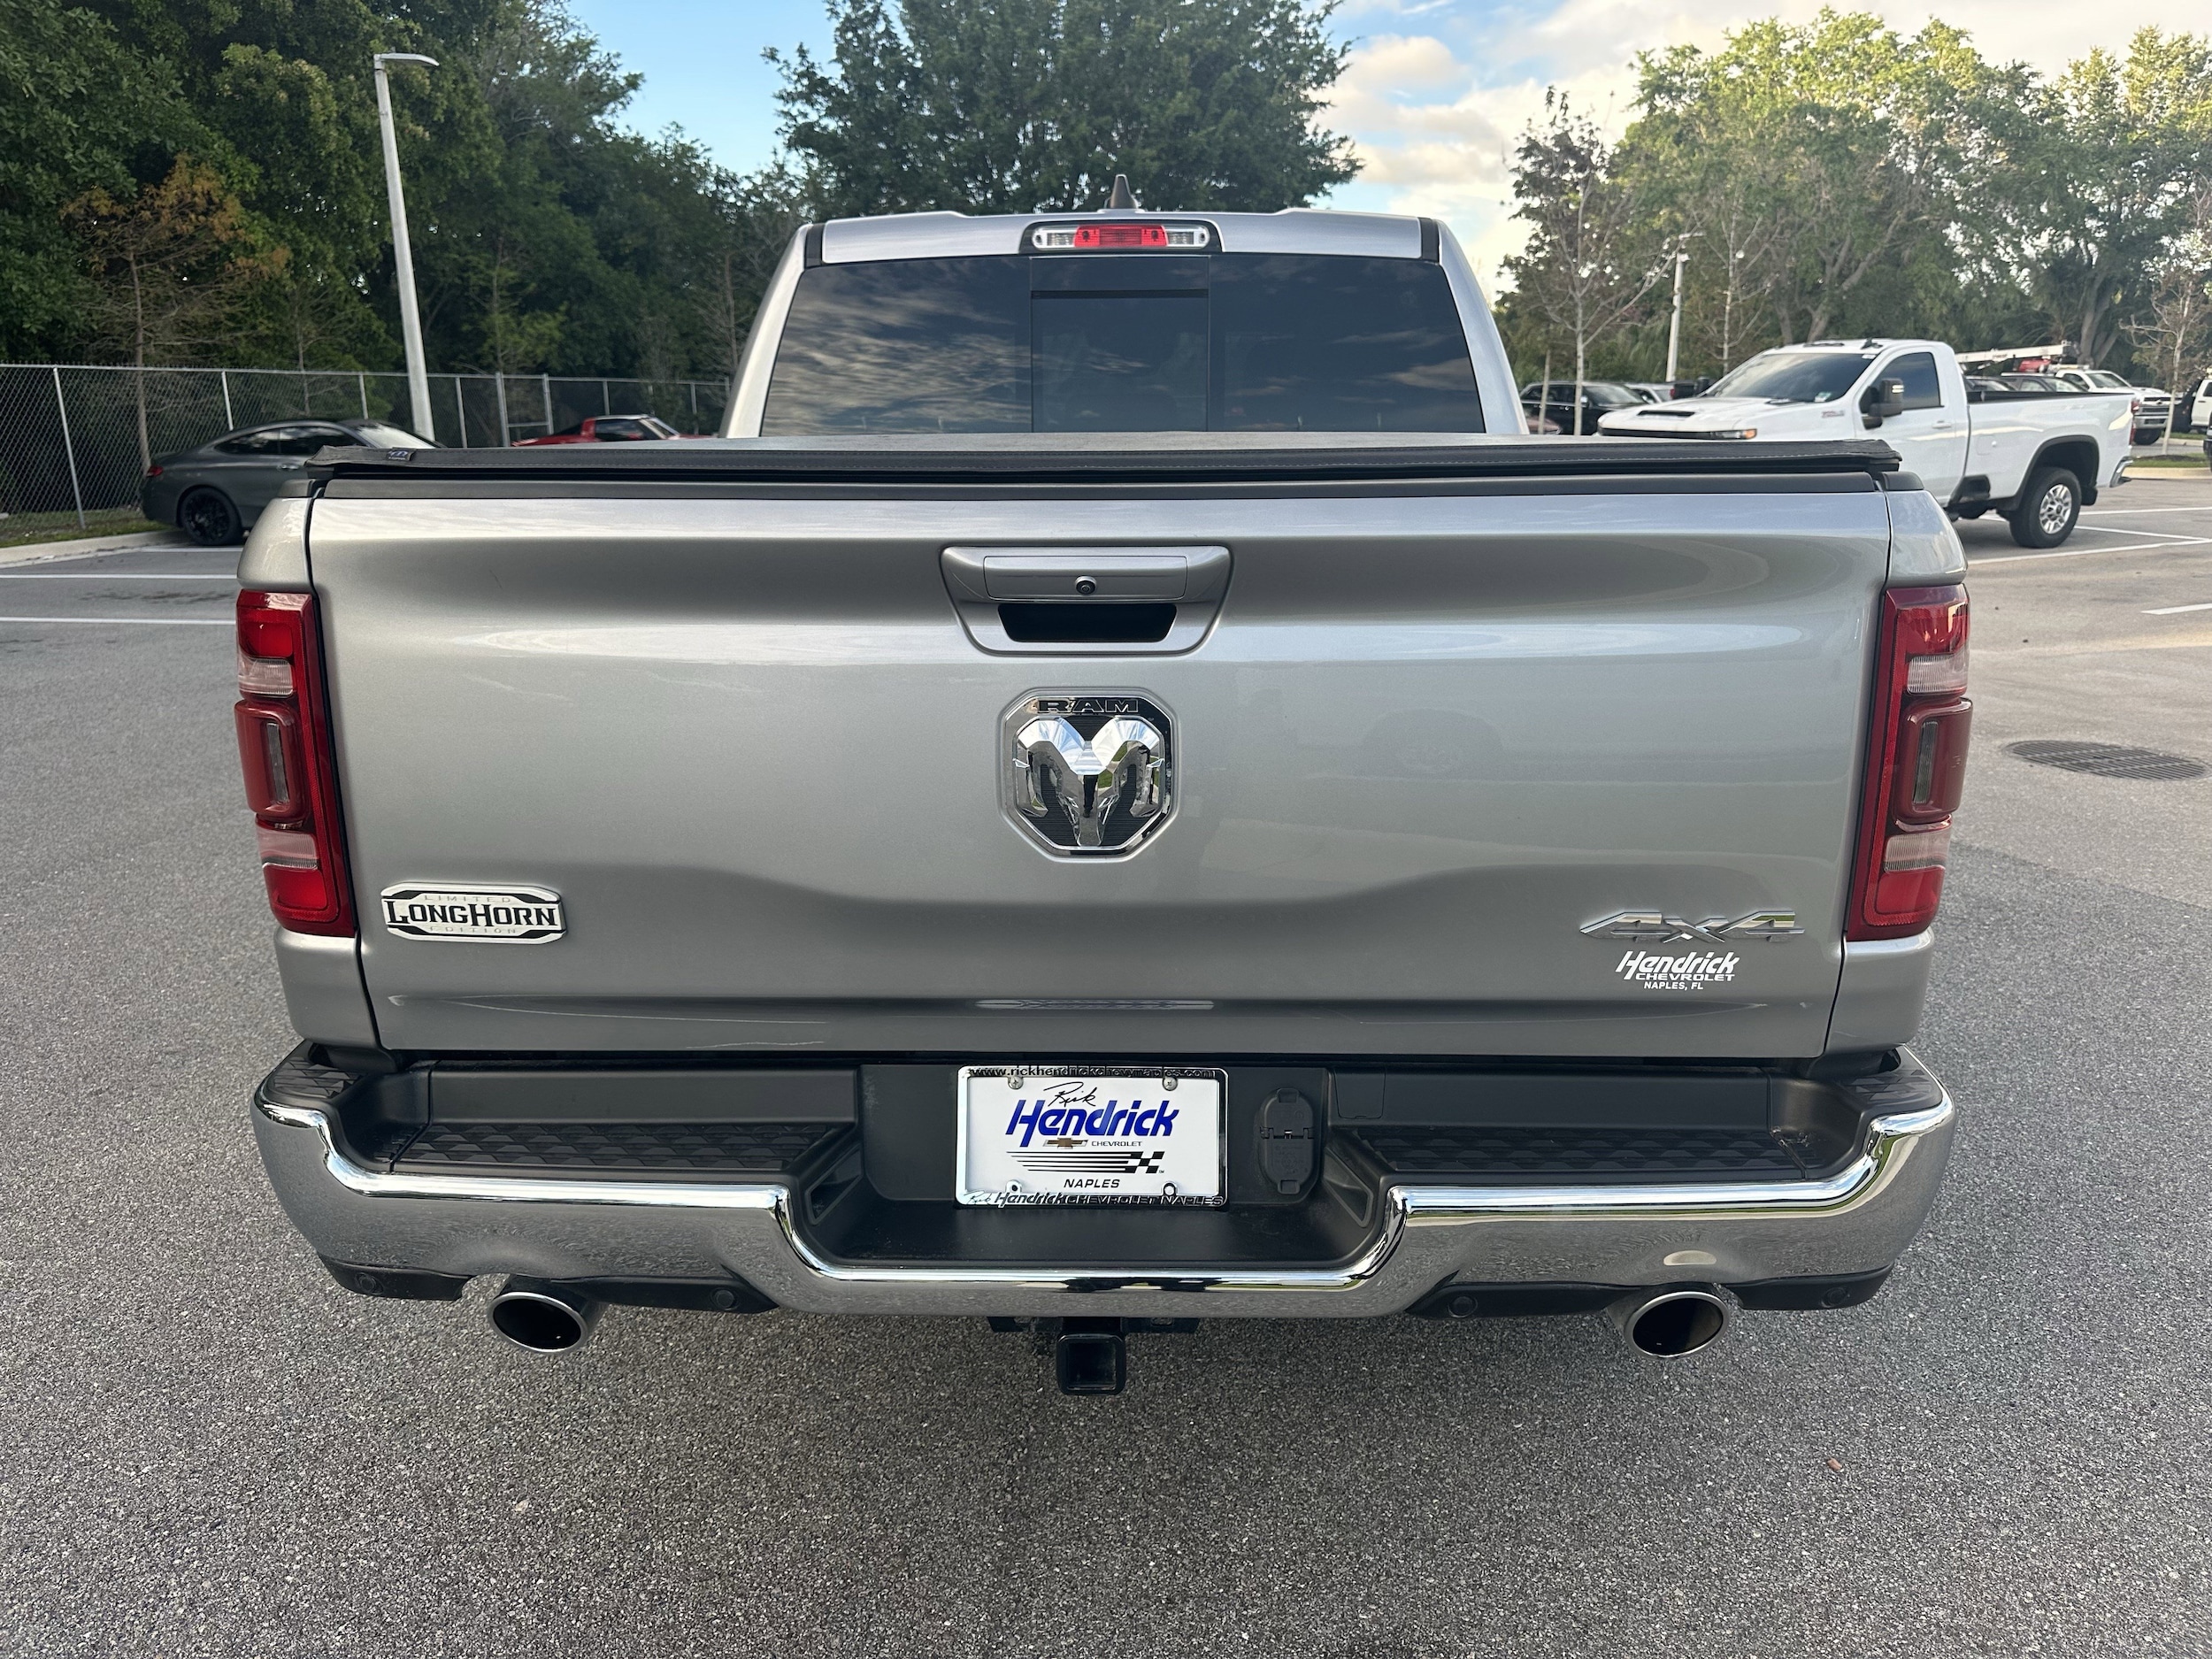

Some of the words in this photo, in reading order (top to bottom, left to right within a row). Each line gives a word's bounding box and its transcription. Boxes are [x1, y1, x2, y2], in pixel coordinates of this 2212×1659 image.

[1038, 699, 1139, 713] RAM
[424, 895, 511, 903] LIMITED
[1616, 950, 1740, 979] Hendrick
[1635, 972, 1735, 981] CHEVROLET
[1644, 981, 1687, 991] NAPLES,
[1005, 1099, 1179, 1148] Hendrick
[1064, 1179, 1120, 1188] NAPLES
[995, 1192, 1063, 1208] Hendrick
[1065, 1194, 1159, 1205] CHEVROLET
[1161, 1194, 1224, 1206] NAPLES
